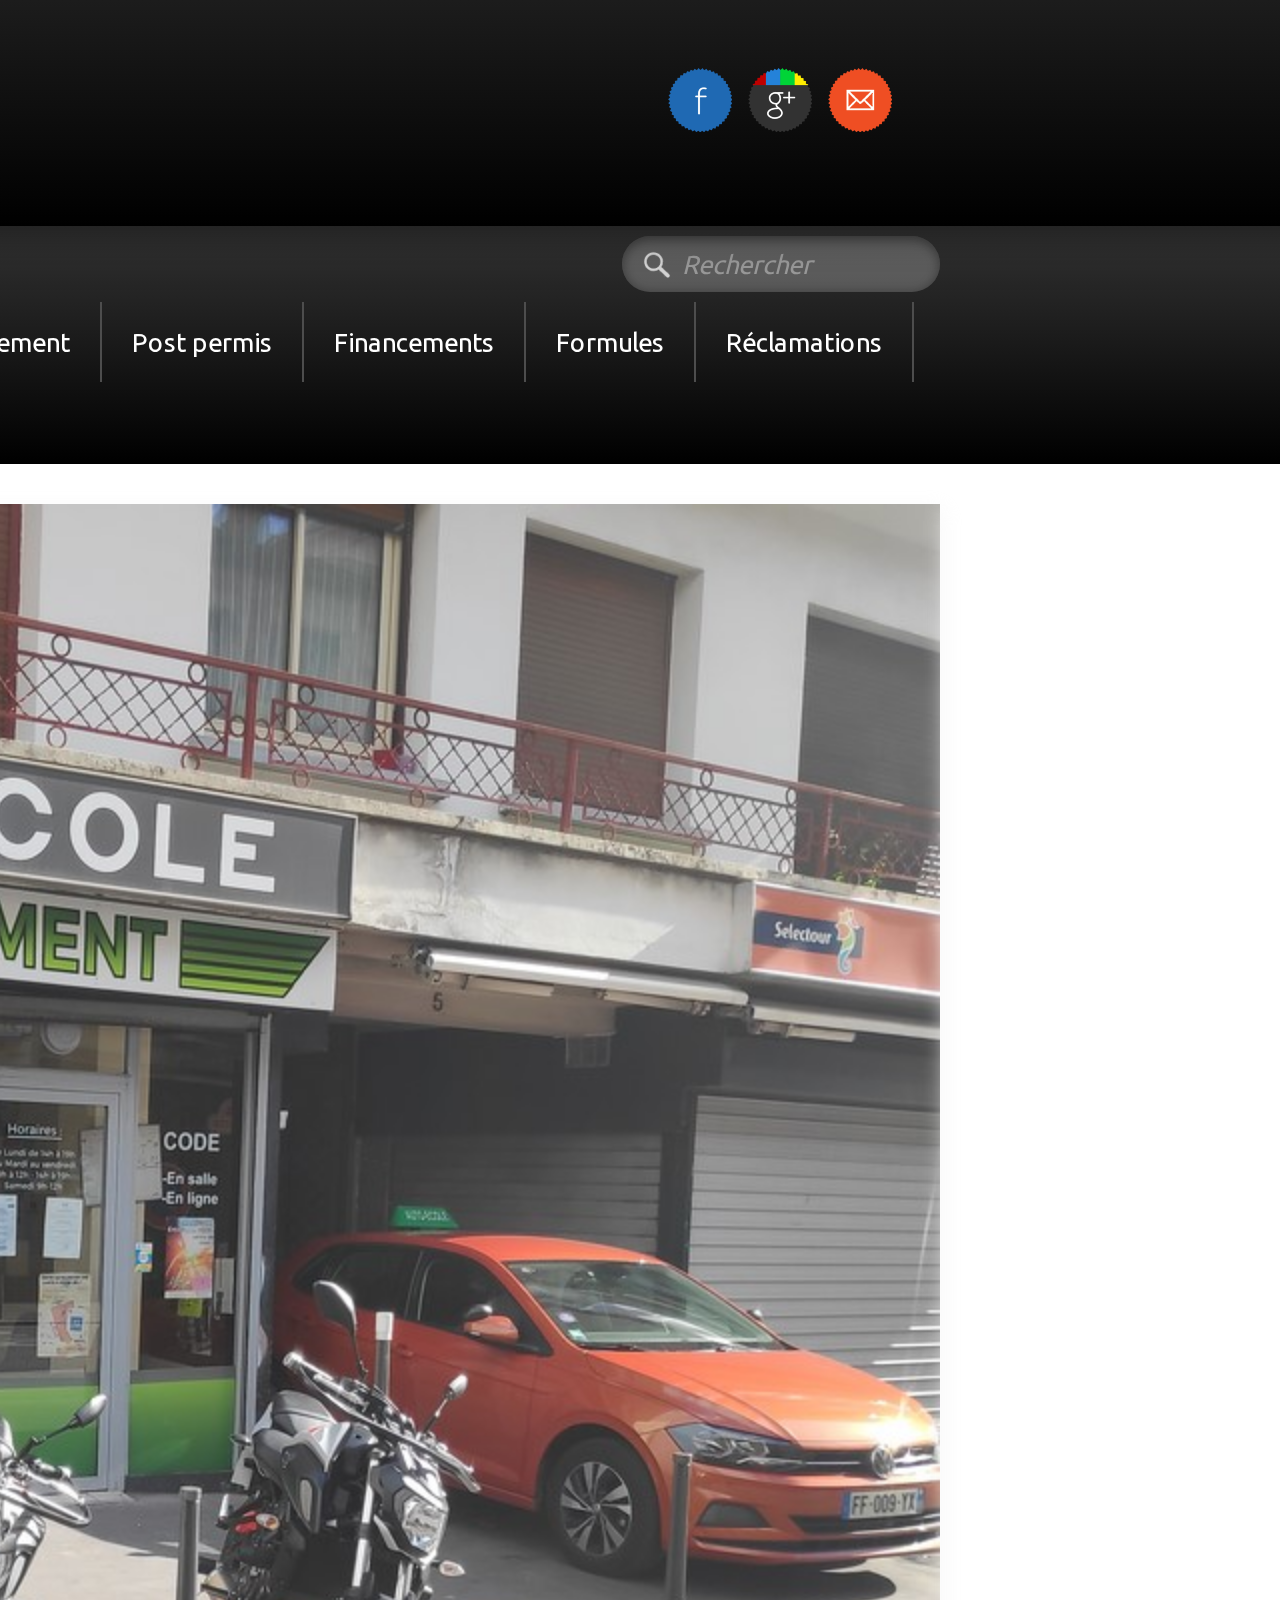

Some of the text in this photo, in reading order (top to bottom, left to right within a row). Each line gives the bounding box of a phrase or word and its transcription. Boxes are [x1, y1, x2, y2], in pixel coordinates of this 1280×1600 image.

[684, 253, 815, 275] Rechercher
[133, 332, 271, 358] Post permis
[335, 332, 493, 353] Financements
[557, 331, 663, 353] Formules
[727, 331, 881, 353] Réclamations
[774, 921, 832, 944] Selectour
[433, 991, 443, 1011] 5
[7, 1123, 58, 1137] Horaires
[163, 1131, 220, 1152] CODE
[188, 1172, 219, 1187] salle
[187, 1191, 219, 1209] ligne
